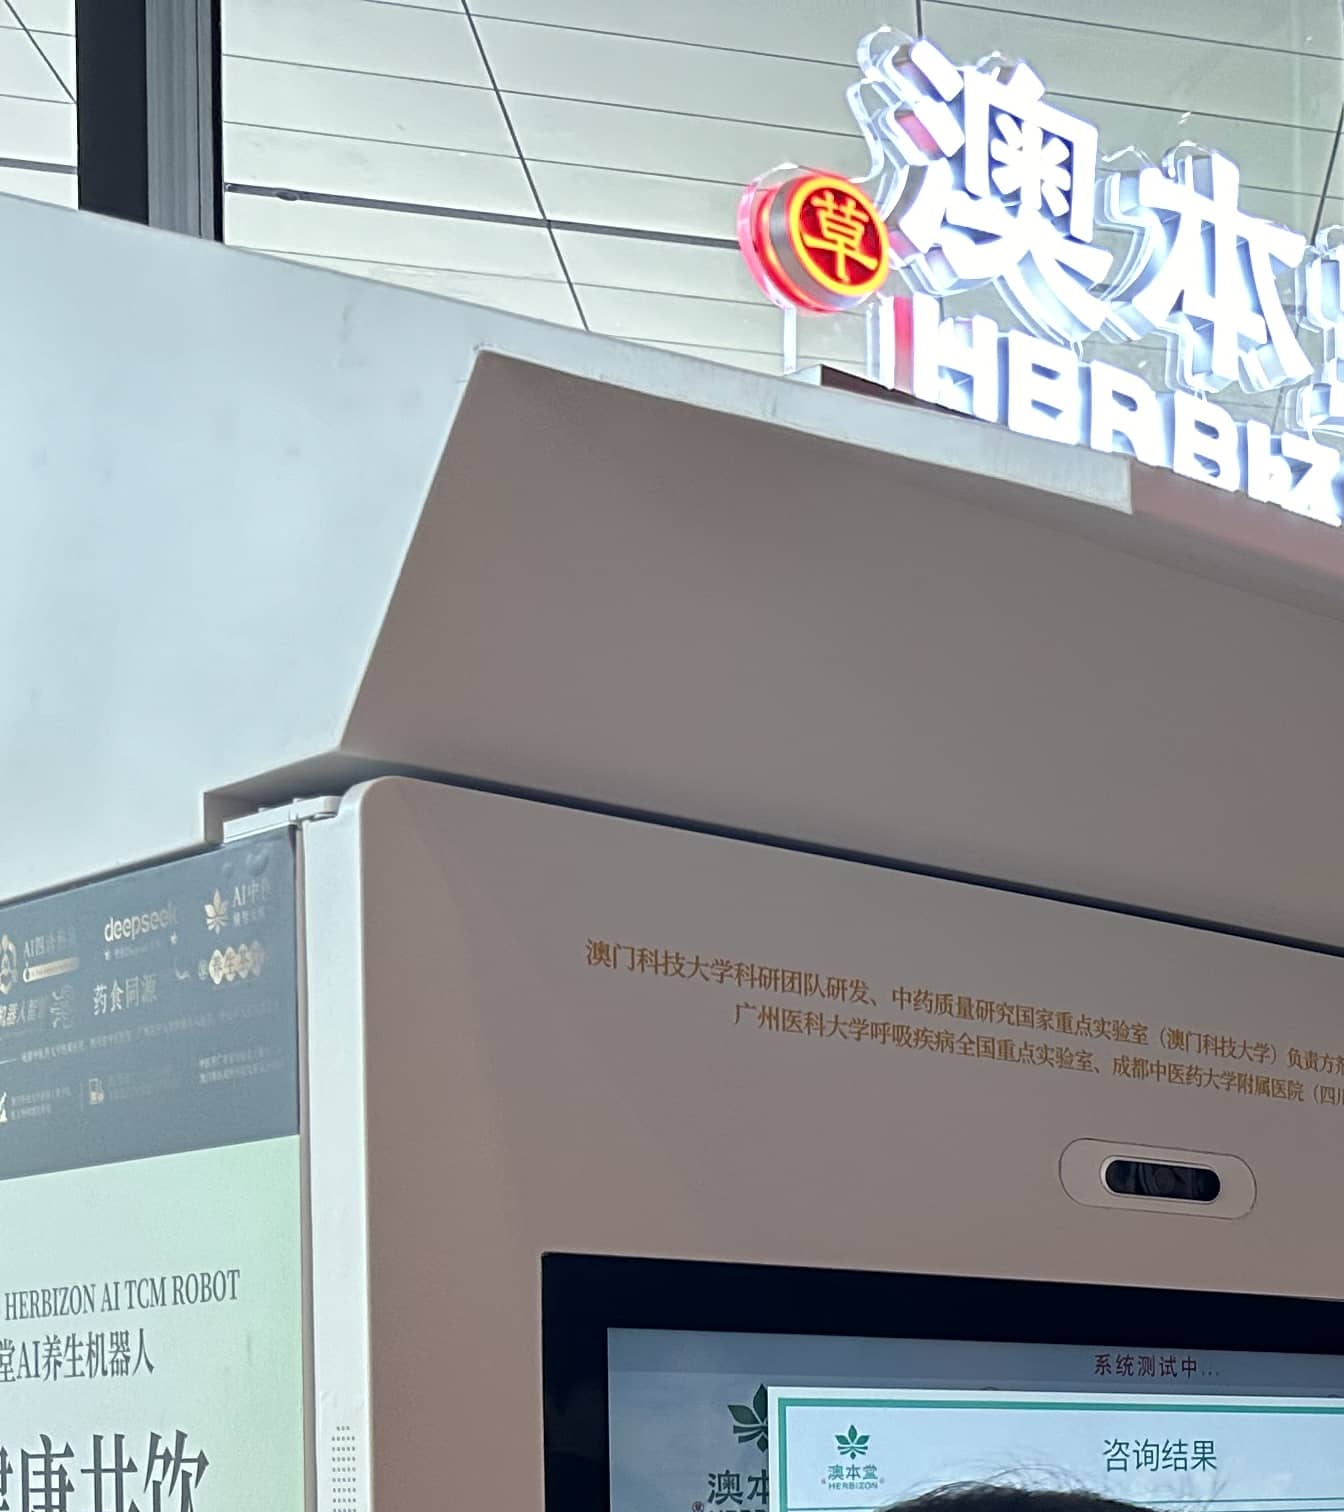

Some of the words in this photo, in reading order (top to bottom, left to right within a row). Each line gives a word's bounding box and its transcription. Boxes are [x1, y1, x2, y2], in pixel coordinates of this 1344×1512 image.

[802, 190, 880, 282] 草
[104, 902, 178, 943] deepseek
[93, 974, 159, 1017] 药食同源
[5, 1283, 96, 1321] HERBIZON
[101, 1281, 121, 1313] AI
[124, 1276, 168, 1309] TCM
[172, 1269, 241, 1306] ROBOT
[0, 1327, 155, 1383] 堂AI养生机器人
[827, 1463, 878, 1481] 澳本堂
[1102, 1438, 1218, 1473] 咨询结果
[707, 1468, 769, 1505] 澳本
[828, 1481, 879, 1491] HERBIZON
